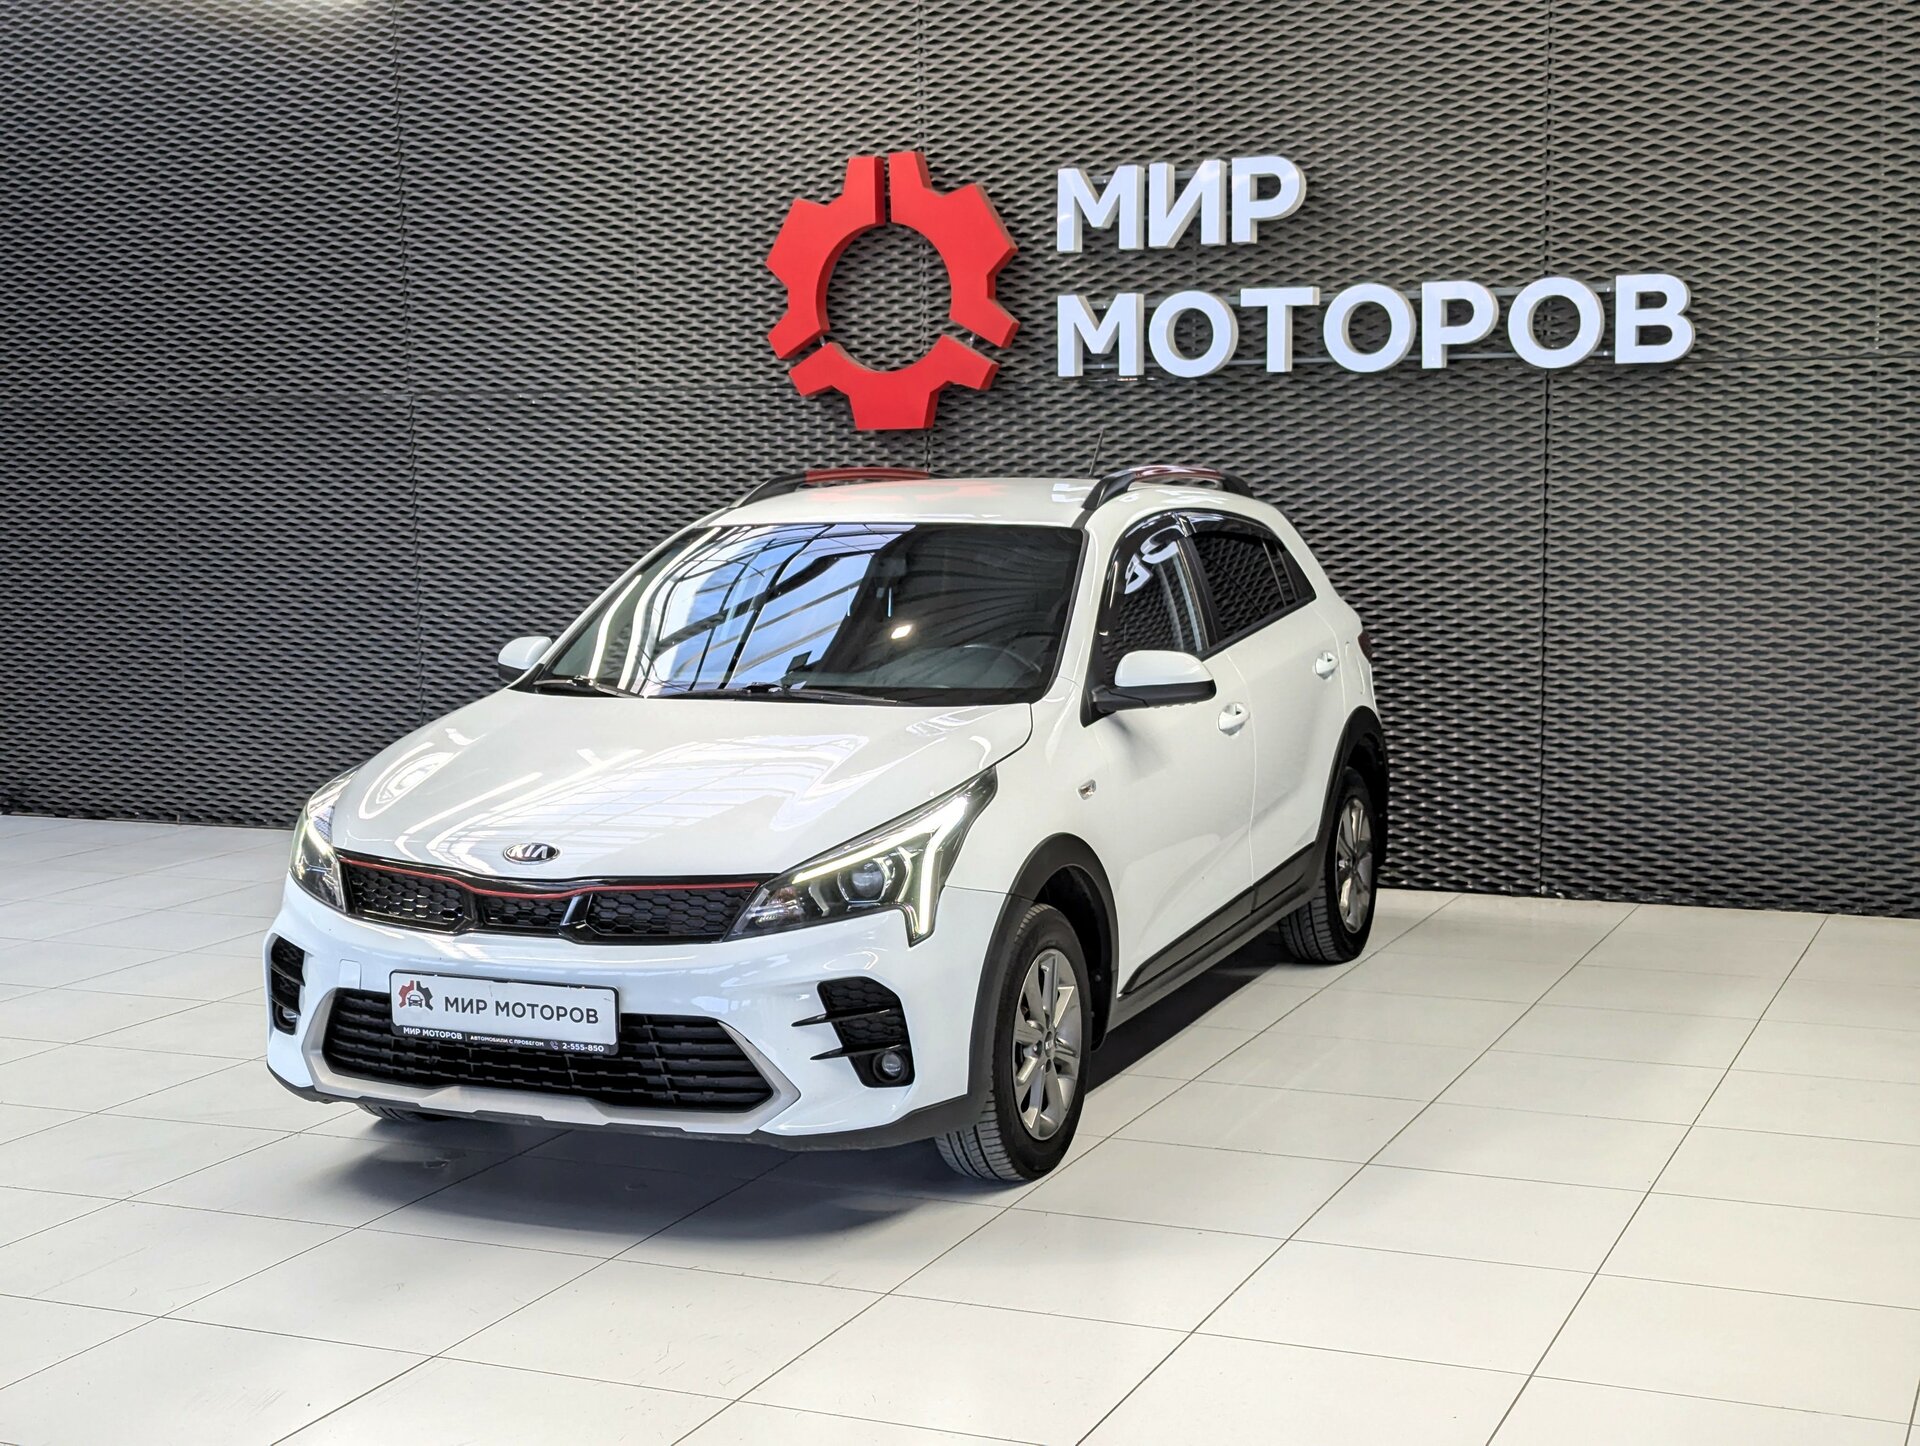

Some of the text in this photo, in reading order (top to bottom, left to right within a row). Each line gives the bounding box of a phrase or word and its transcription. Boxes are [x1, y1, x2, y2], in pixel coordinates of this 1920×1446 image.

[1056, 155, 1307, 253] МИР
[1056, 274, 1695, 378] МОТОРОВ
[507, 844, 548, 859] KIA
[444, 996, 599, 1024] МИР МОТОРОВ
[403, 1027, 463, 1040] МИР МОТОРОВ
[470, 1035, 508, 1044] АВТОМОБИЛИ
[514, 1039, 544, 1047] ПРОБЕГОМ
[562, 1042, 604, 1053] 2-555-850
